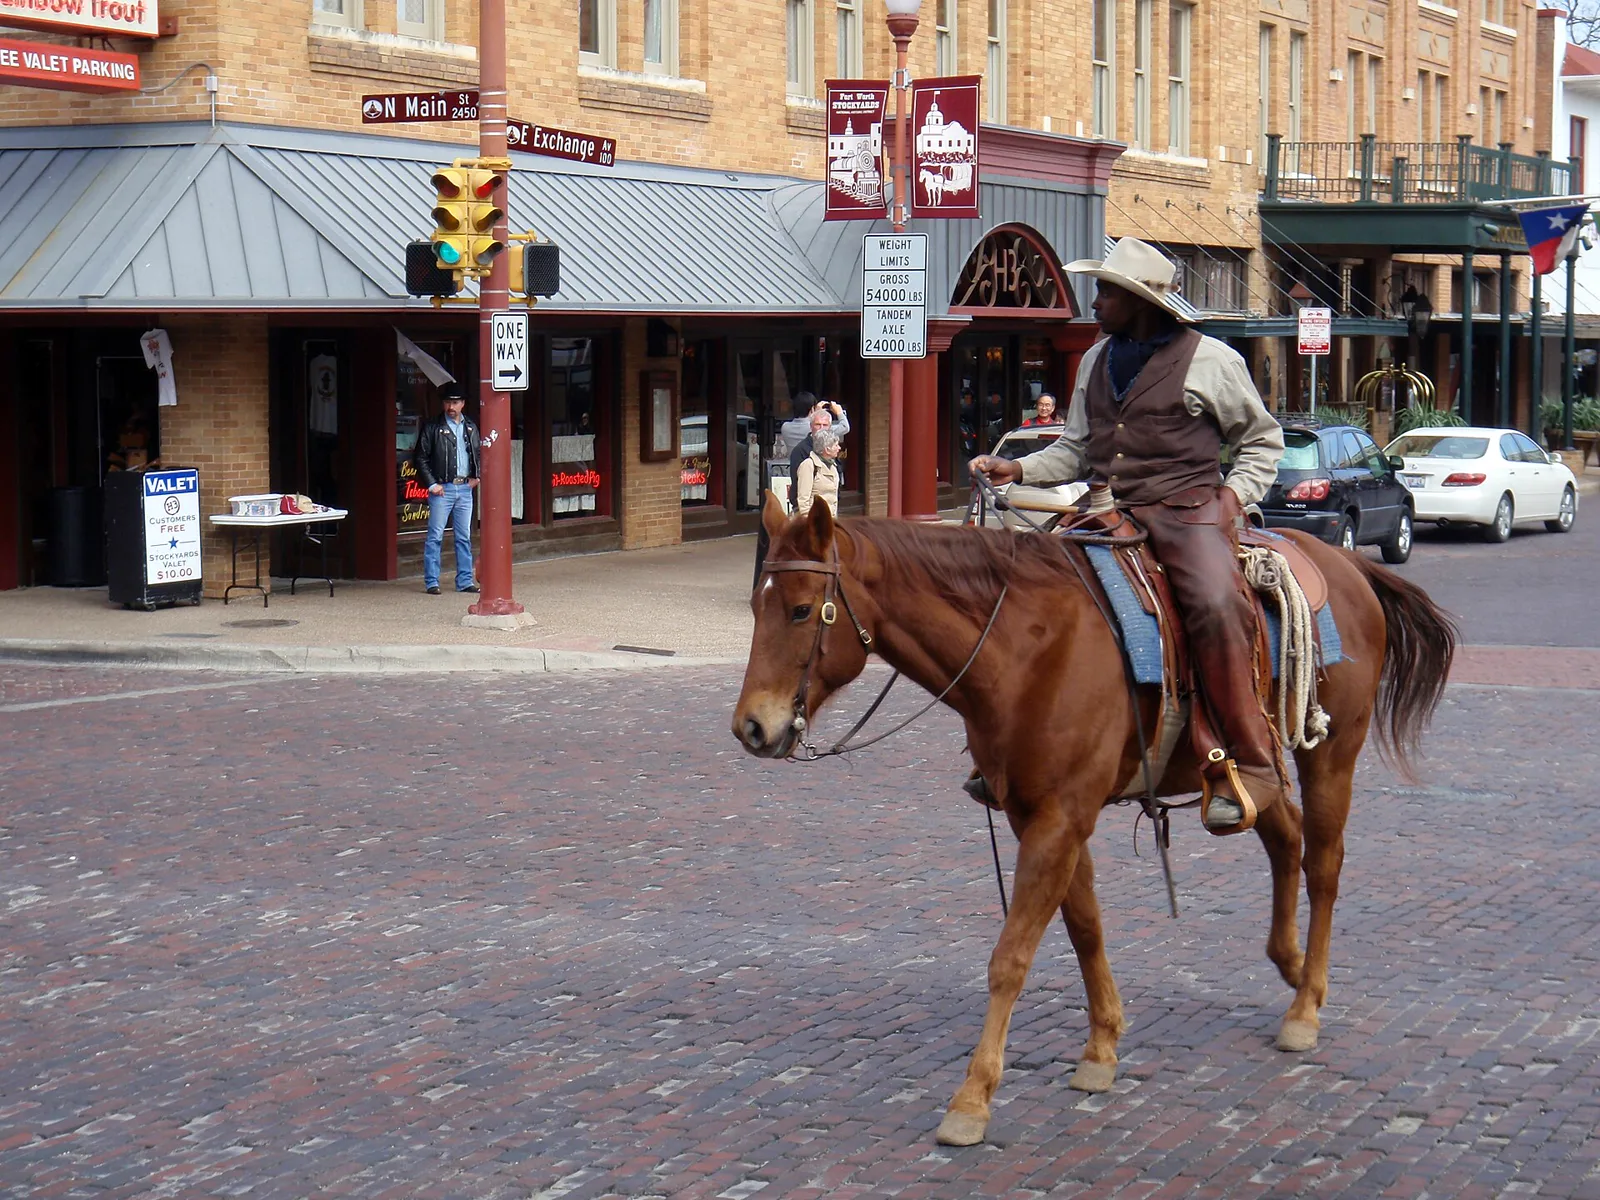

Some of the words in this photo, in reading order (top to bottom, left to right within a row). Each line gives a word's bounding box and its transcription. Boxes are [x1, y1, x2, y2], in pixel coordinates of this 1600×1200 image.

[0, 49, 20, 67] EE
[23, 52, 68, 72] VALET
[72, 58, 135, 80] PARKING
[458, 93, 469, 105] St
[839, 93, 853, 101] Fort
[384, 97, 396, 118] N
[405, 95, 447, 118] Main
[832, 101, 880, 109] STOCKYARDS
[451, 106, 477, 119] 2450
[520, 125, 529, 145] E
[533, 127, 595, 162] Exchange
[602, 139, 612, 152] Av
[599, 152, 612, 165] 100
[879, 239, 912, 250] WEIGHT
[880, 256, 910, 267] LIMITS
[879, 274, 910, 285] GROSS
[866, 288, 906, 302] 54000
[908, 291, 923, 302] LBS
[876, 309, 912, 320] TANDEM
[496, 322, 523, 339] ONE
[882, 324, 905, 335] AXLE
[496, 342, 523, 360] WAY
[865, 338, 905, 352] 24000
[907, 342, 921, 352] LBS
[146, 476, 196, 493] VALET
[552, 469, 588, 488] it-Roasted
[149, 514, 196, 525] CUSTOMERS
[160, 524, 186, 534] FREE
[149, 550, 199, 562] STOCKYARDS
[163, 560, 187, 568] VALET
[157, 567, 193, 580] $10.00
